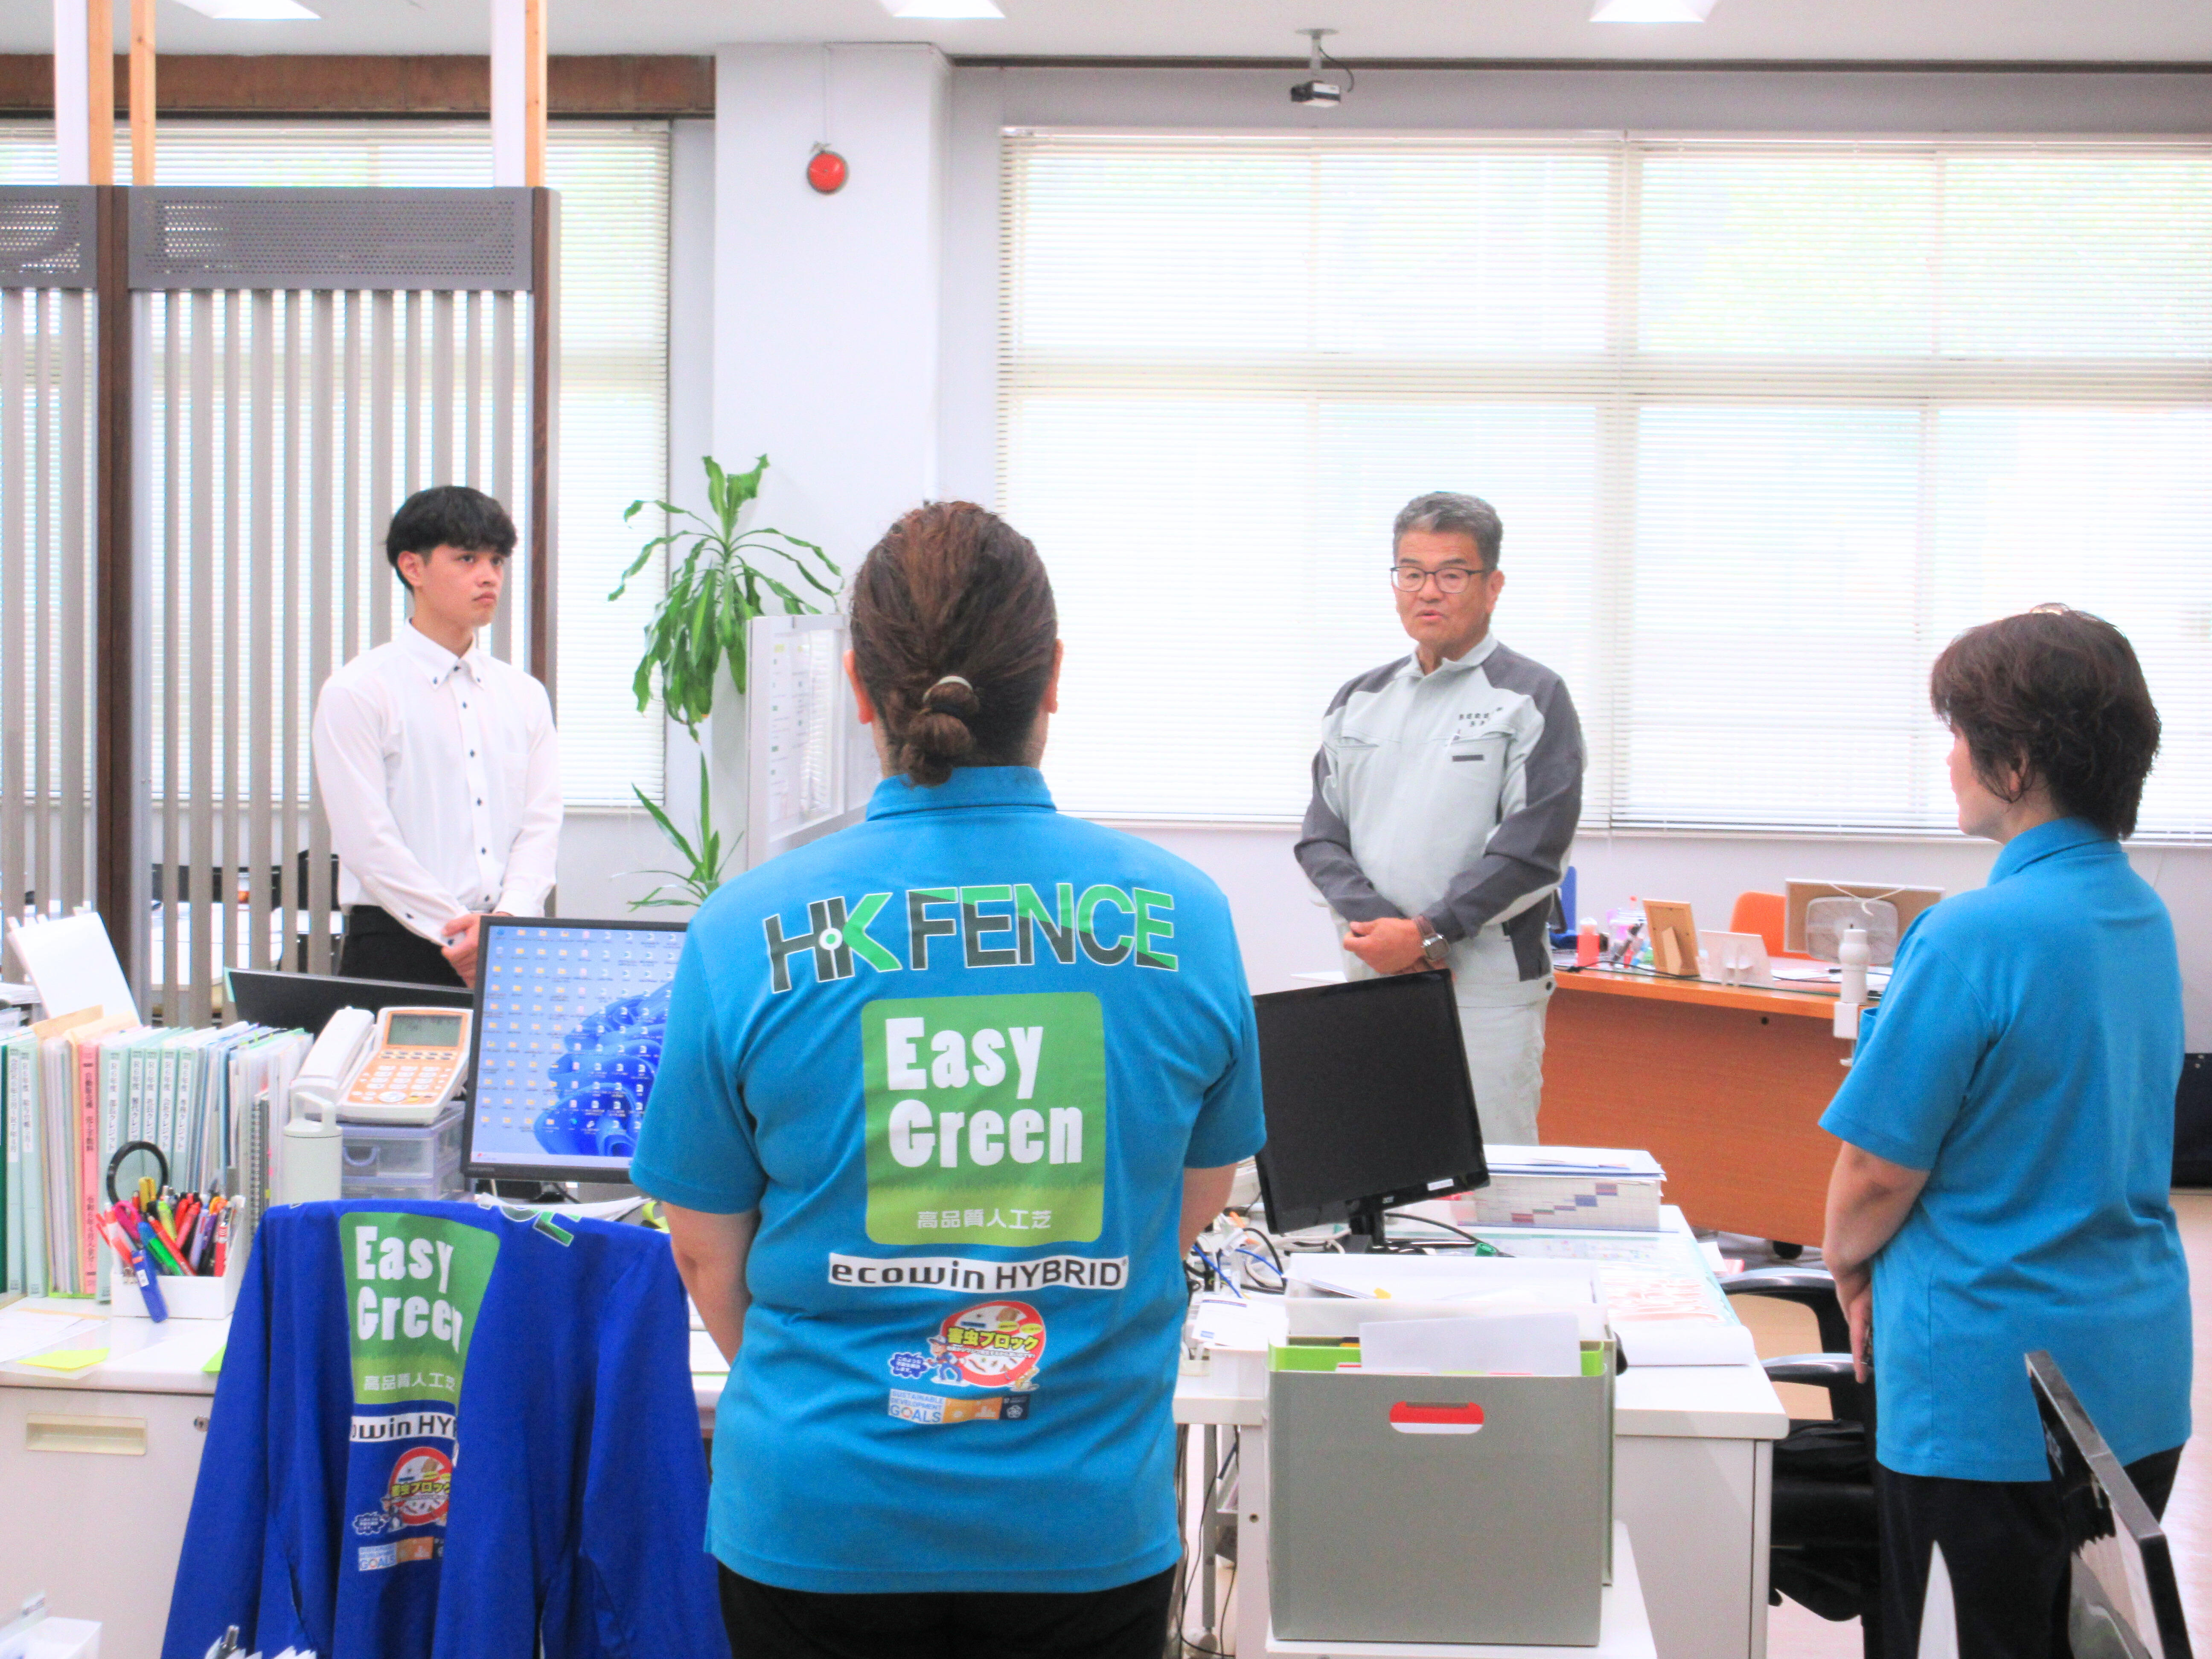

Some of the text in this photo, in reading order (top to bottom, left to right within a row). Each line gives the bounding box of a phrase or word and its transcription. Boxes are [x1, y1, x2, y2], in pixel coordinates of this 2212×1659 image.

[906, 882, 1179, 972] FENCE
[885, 1016, 1044, 1099] Easy
[889, 1099, 1083, 1167] Green
[917, 1209, 1052, 1229] 高品質人工芝
[355, 1226, 454, 1294] Easy
[831, 1260, 984, 1289] ecowin
[947, 1327, 1039, 1351] 害虫ブロック
[891, 1404, 941, 1423] GOALS
